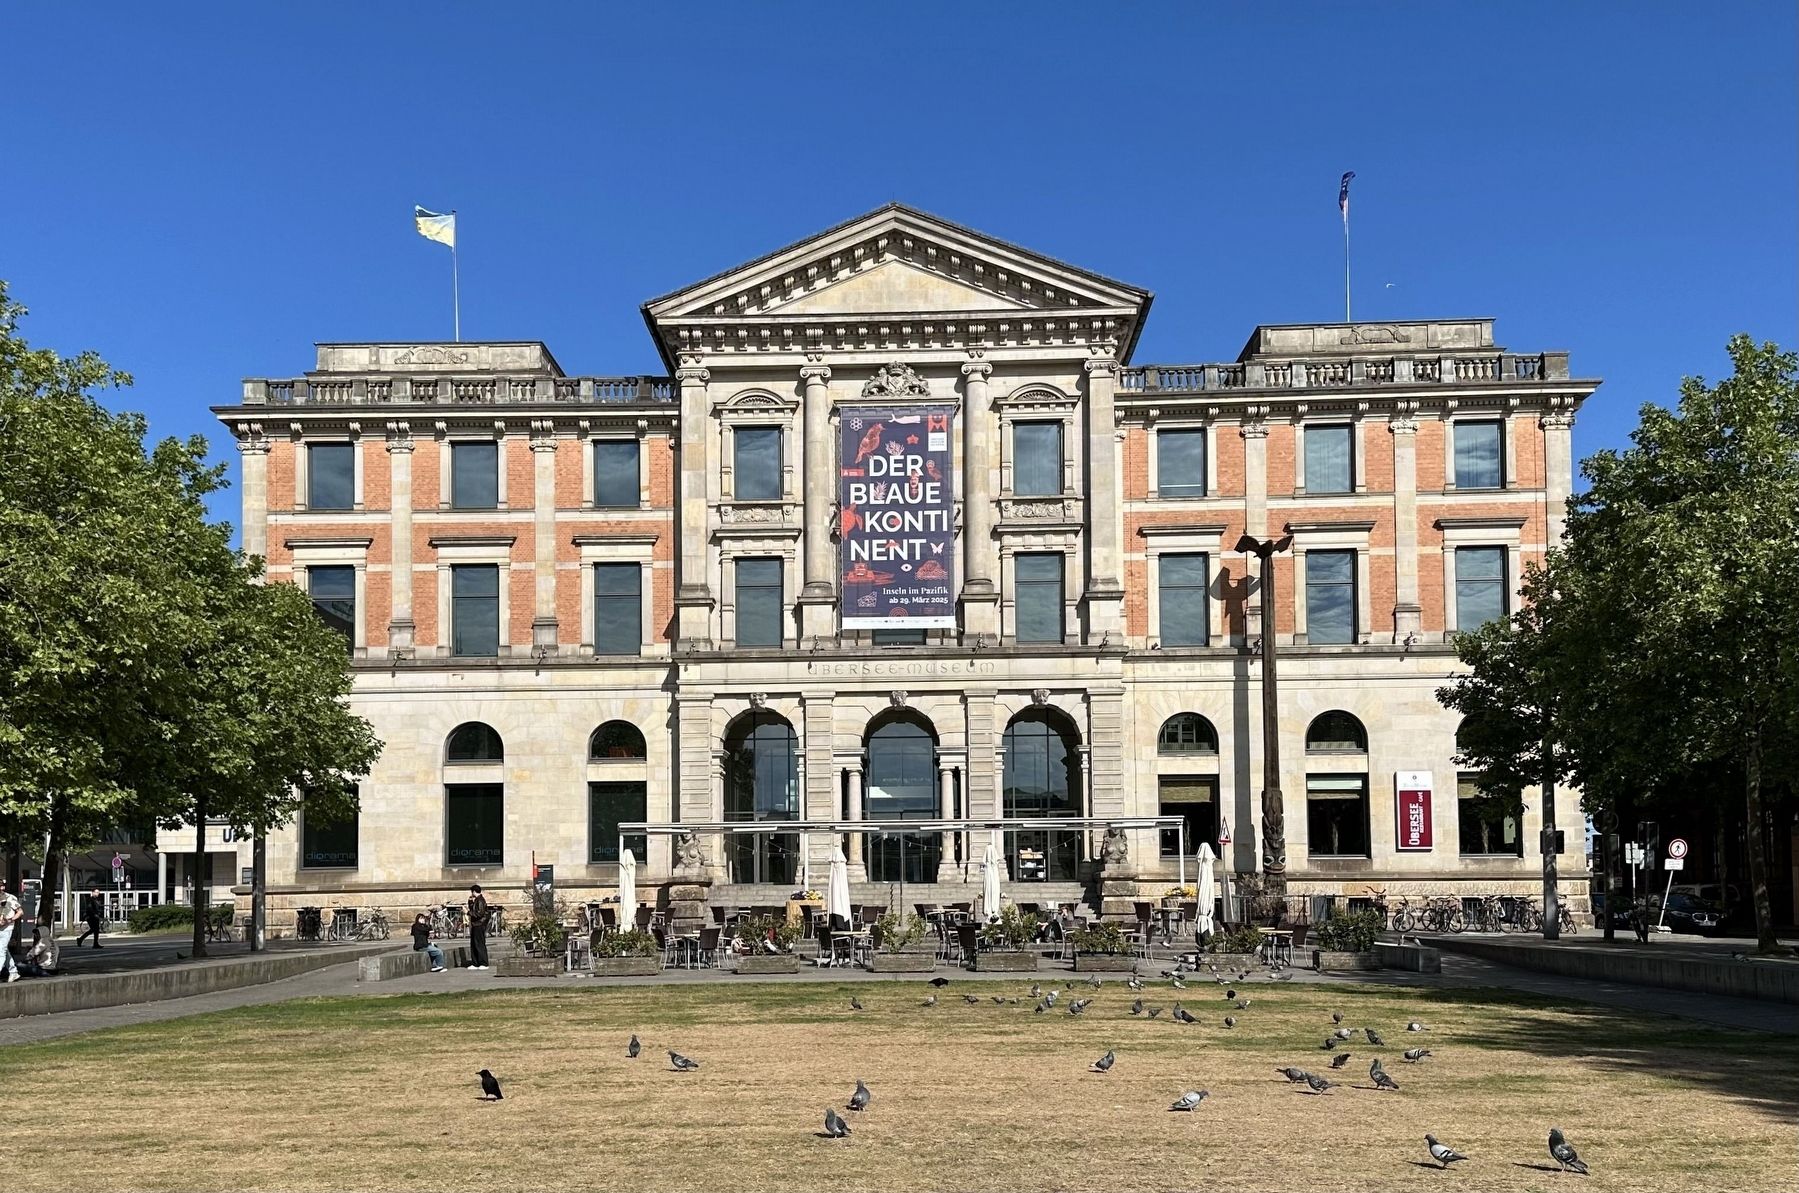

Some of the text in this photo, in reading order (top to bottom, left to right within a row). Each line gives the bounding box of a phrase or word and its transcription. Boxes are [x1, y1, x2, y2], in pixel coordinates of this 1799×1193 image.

[869, 455, 924, 477] DER
[850, 482, 941, 505] BLAUE
[865, 510, 948, 533] KONTI
[850, 539, 927, 561] NENT
[883, 586, 949, 595] Inseln im Pazifik
[912, 596, 930, 604] März
[931, 596, 949, 604] 2025
[1409, 803, 1420, 846] ÜBERSEE
